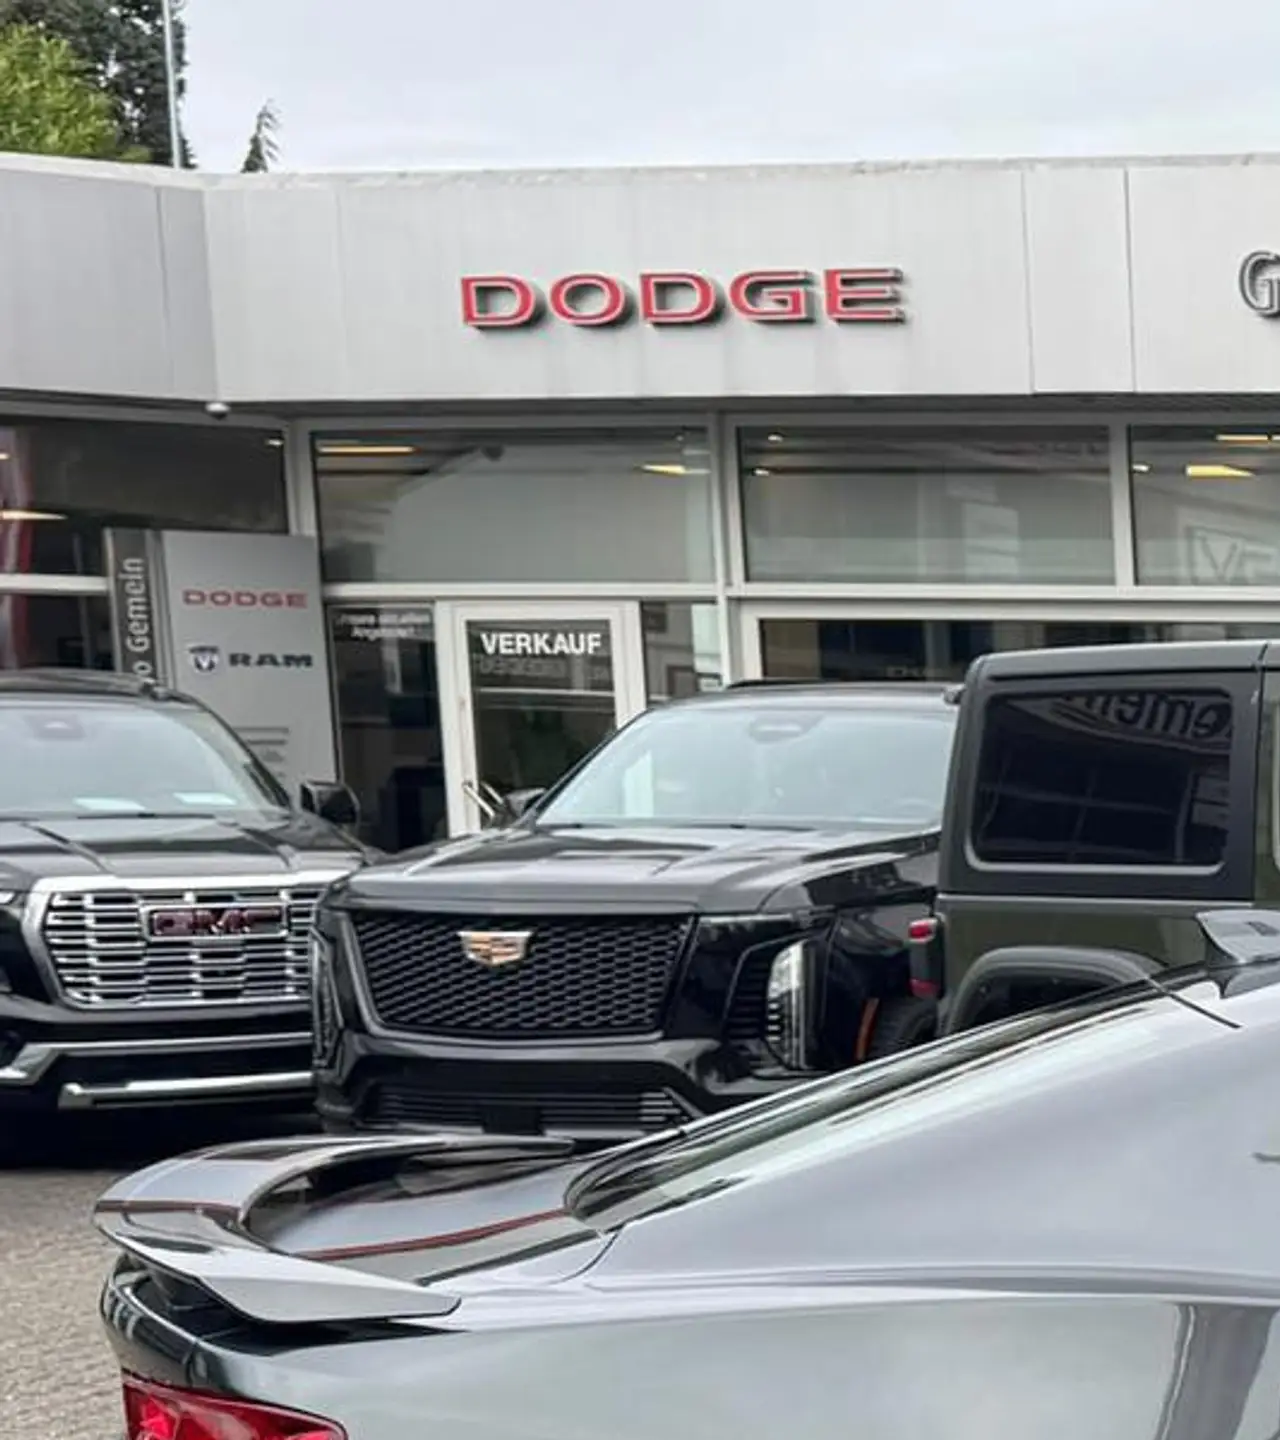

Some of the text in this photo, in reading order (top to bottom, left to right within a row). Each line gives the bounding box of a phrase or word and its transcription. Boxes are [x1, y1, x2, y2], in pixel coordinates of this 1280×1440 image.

[460, 268, 908, 327] DODGE
[119, 556, 152, 652] Gemein
[182, 590, 309, 609] DODGE
[480, 632, 603, 655] VERKAUF
[228, 652, 315, 668] RAM
